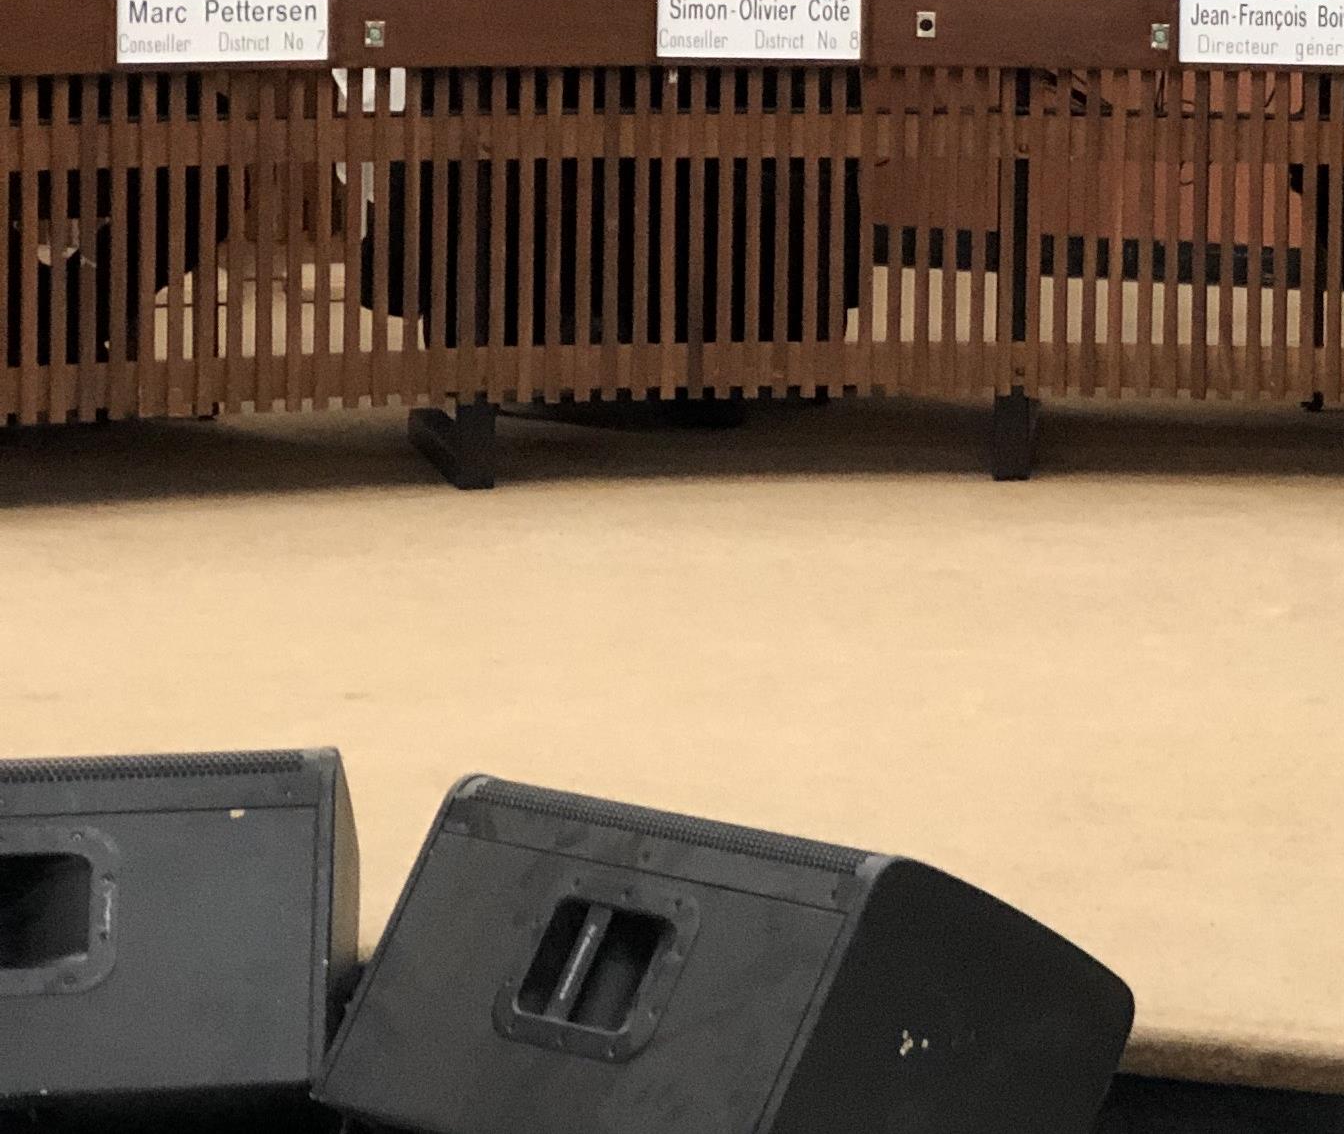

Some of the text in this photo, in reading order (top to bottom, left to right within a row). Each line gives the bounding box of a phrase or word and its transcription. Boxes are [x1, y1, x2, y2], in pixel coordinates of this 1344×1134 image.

[129, 0, 187, 24] Marc
[1191, 3, 1307, 31] Jean-François
[118, 29, 326, 54] Conseiller District No 7
[659, 29, 859, 50] Conseiller District No 8
[1197, 34, 1279, 55] Directeur
